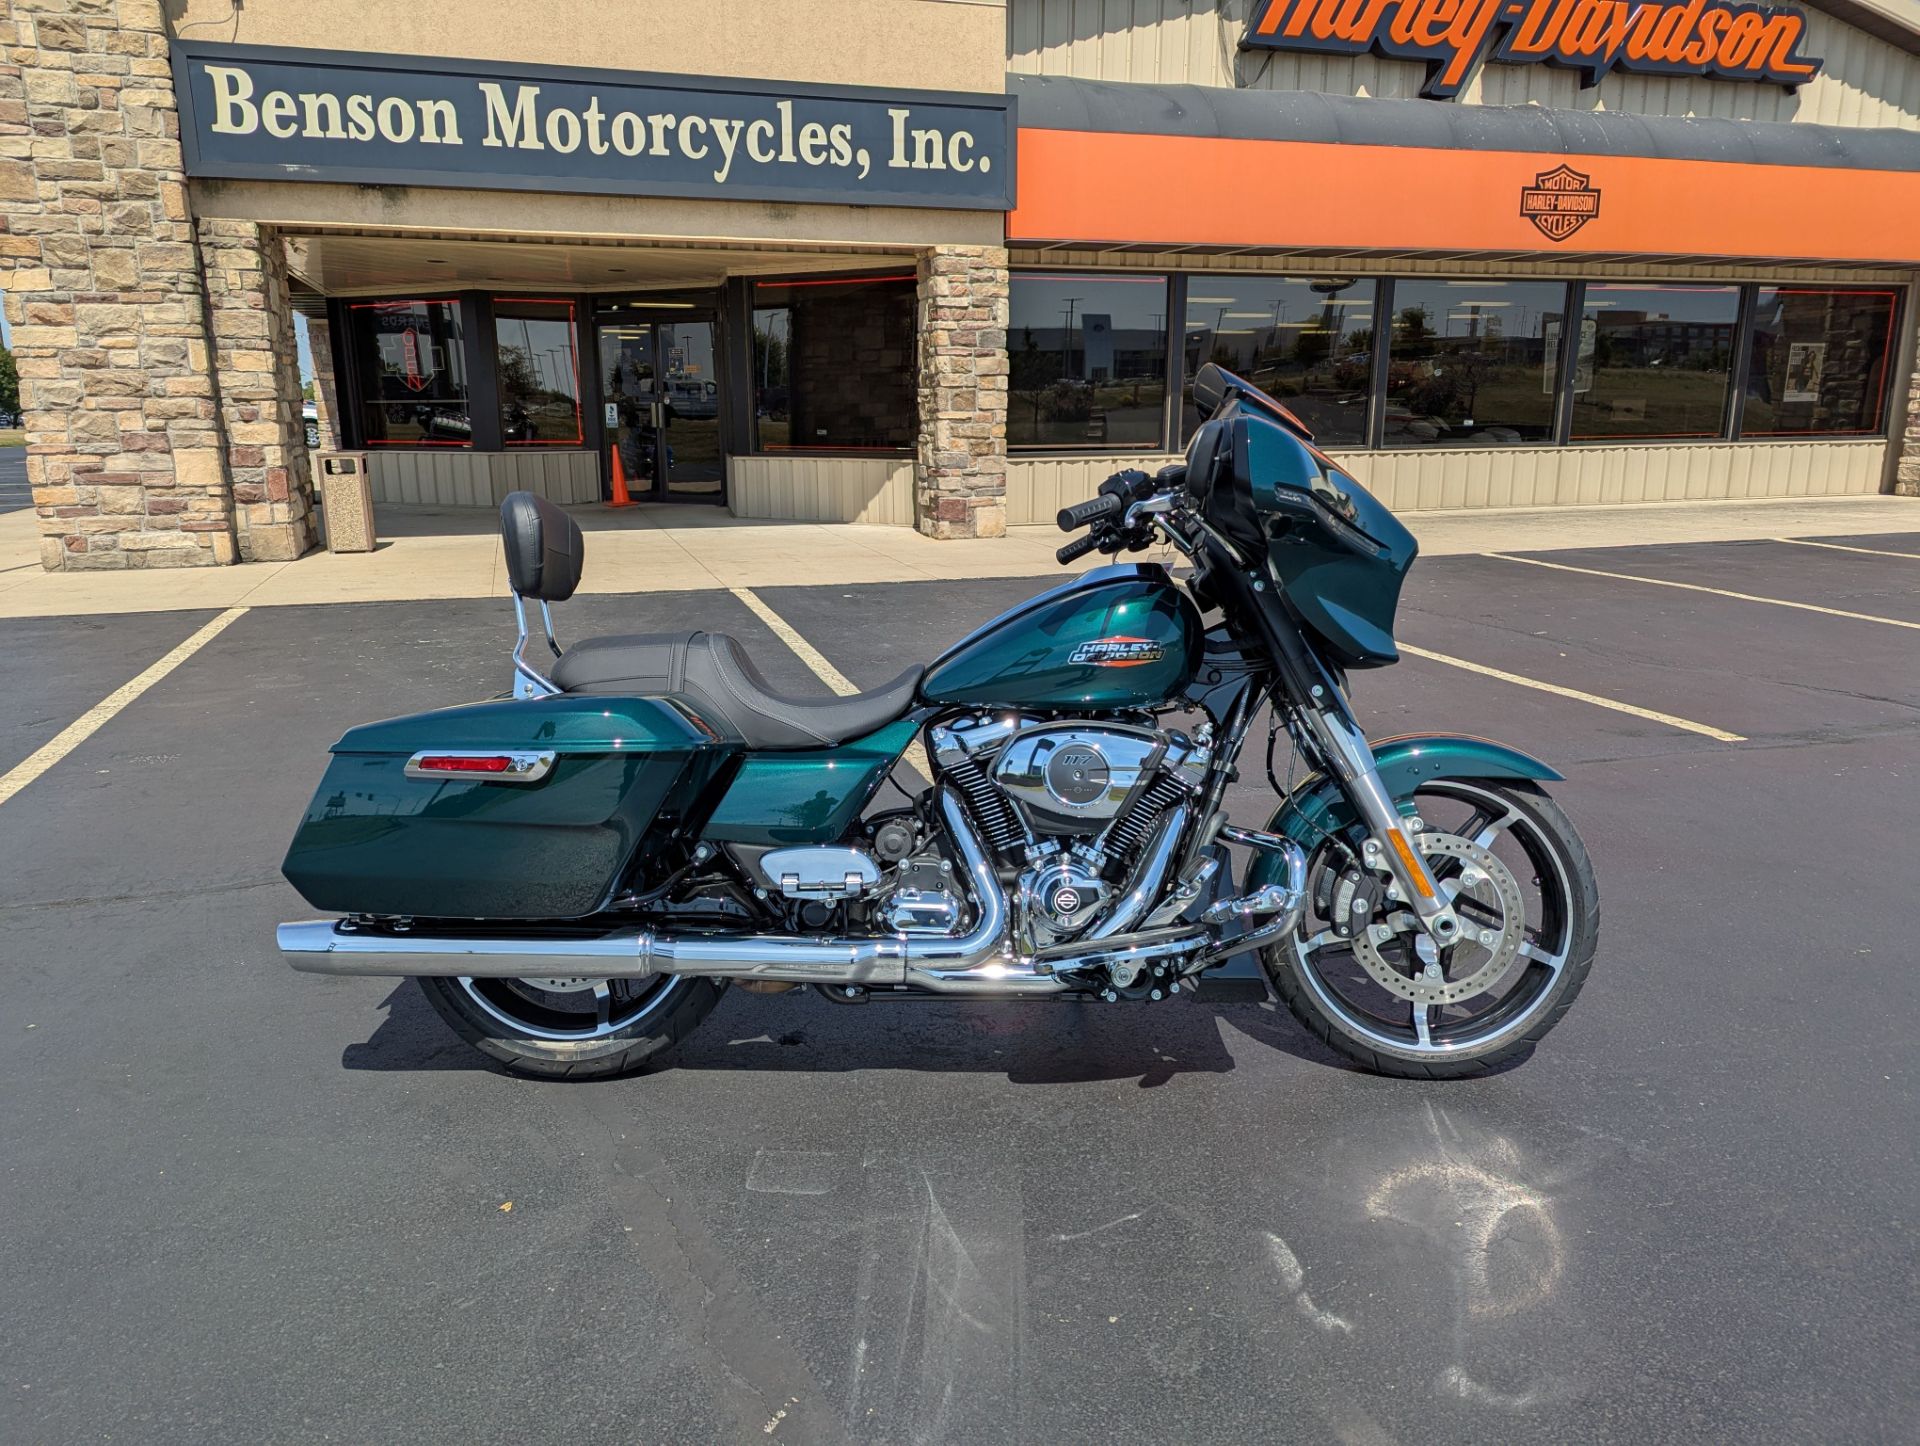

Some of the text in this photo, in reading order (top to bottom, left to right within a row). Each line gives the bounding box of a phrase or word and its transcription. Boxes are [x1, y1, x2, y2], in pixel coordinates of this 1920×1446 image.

[204, 65, 991, 183] Benson Motorcycles, Inc.
[1545, 173, 1580, 190] MOTOR
[1527, 194, 1594, 211] HARLEY-DAVIDSON
[1541, 216, 1577, 234] CYCLES
[403, 331, 421, 390] OPEN
[1073, 651, 1161, 661] DIDSON
[1063, 754, 1095, 765] 117
